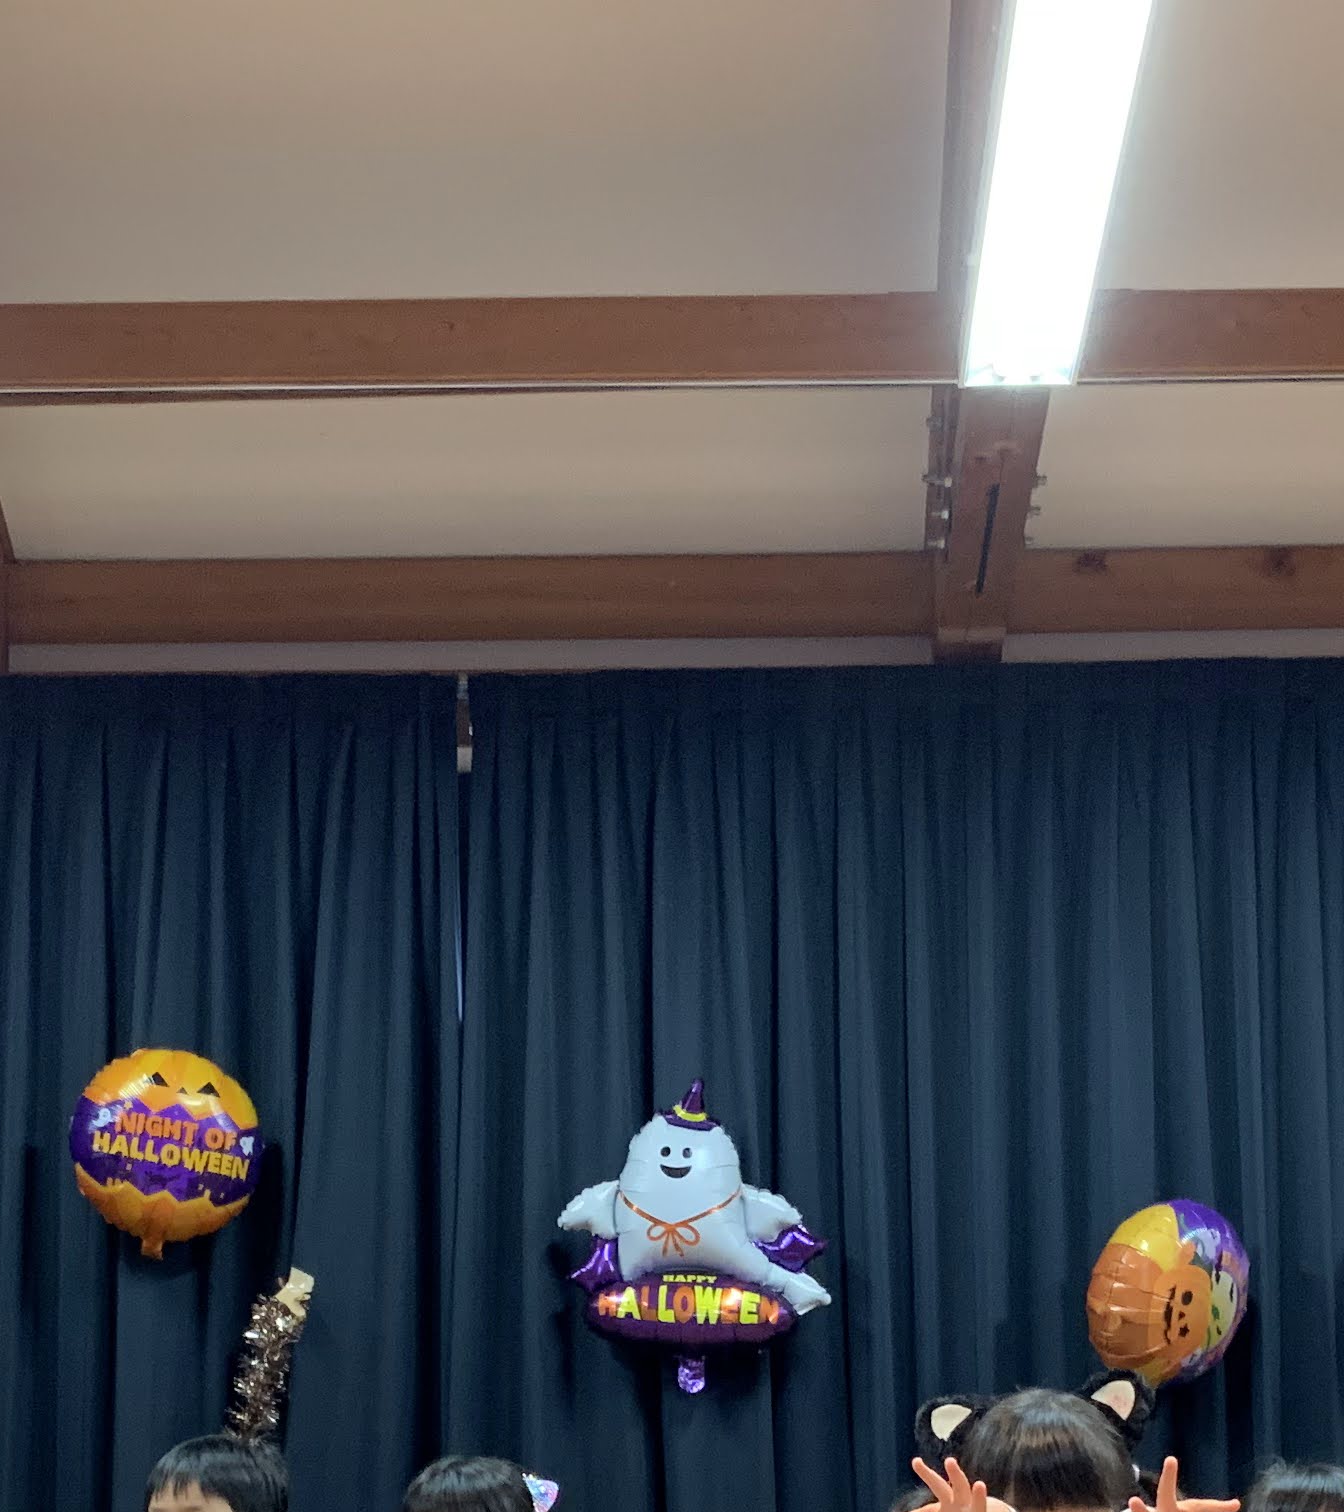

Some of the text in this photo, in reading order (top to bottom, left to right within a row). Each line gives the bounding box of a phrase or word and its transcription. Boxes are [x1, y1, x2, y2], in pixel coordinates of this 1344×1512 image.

[115, 1112, 238, 1151] NIGHT OF
[92, 1130, 250, 1181] HALLOWEEN
[662, 1274, 718, 1284] HAPPY
[597, 1284, 780, 1325] HALLOWEEN
